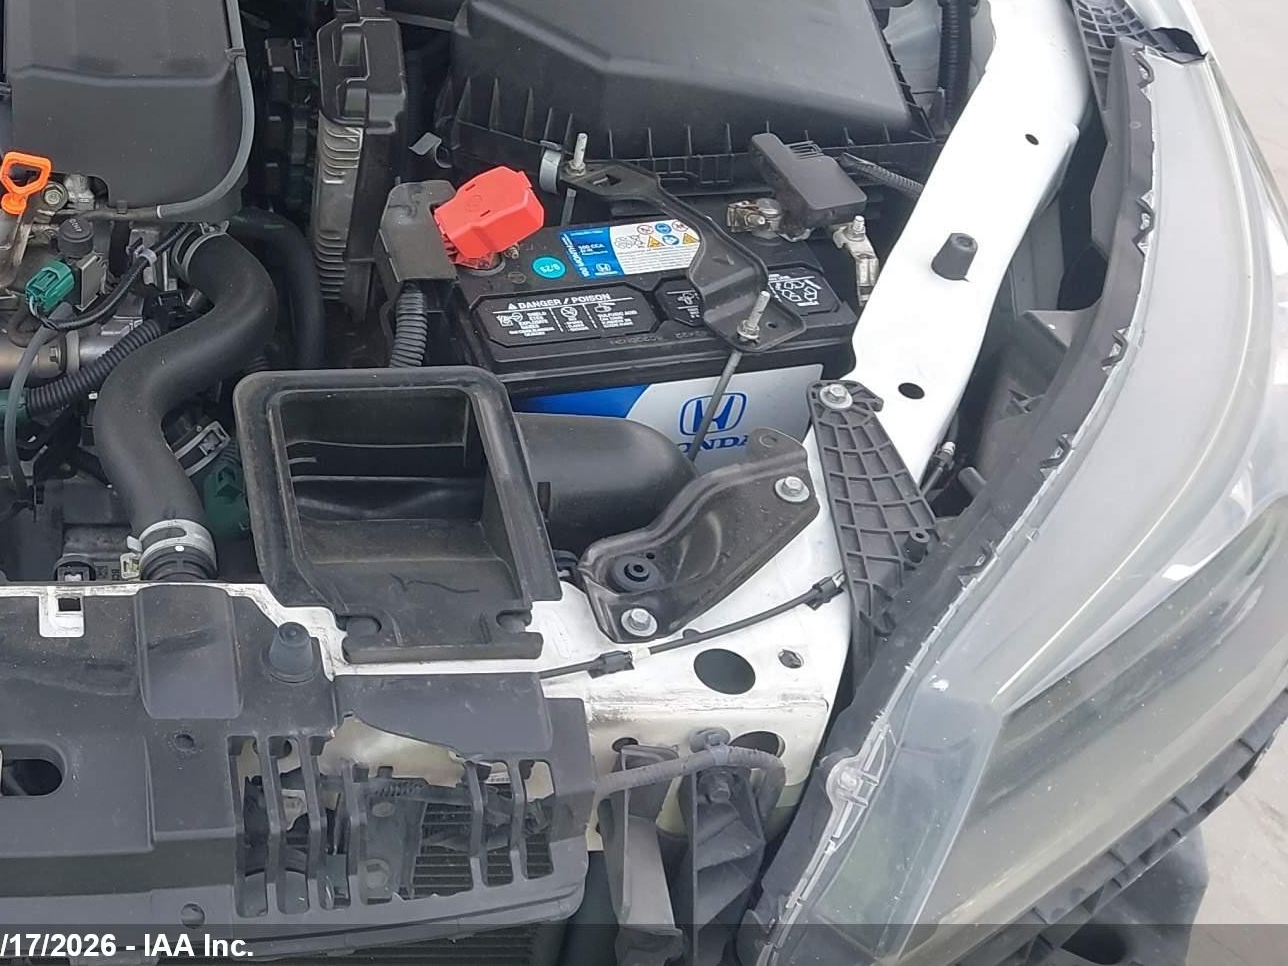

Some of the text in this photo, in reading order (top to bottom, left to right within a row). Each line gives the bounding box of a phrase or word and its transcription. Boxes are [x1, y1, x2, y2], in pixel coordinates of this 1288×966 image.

[517, 299, 562, 309] DANGER
[572, 293, 611, 303] POISON
[677, 435, 749, 453] OND
